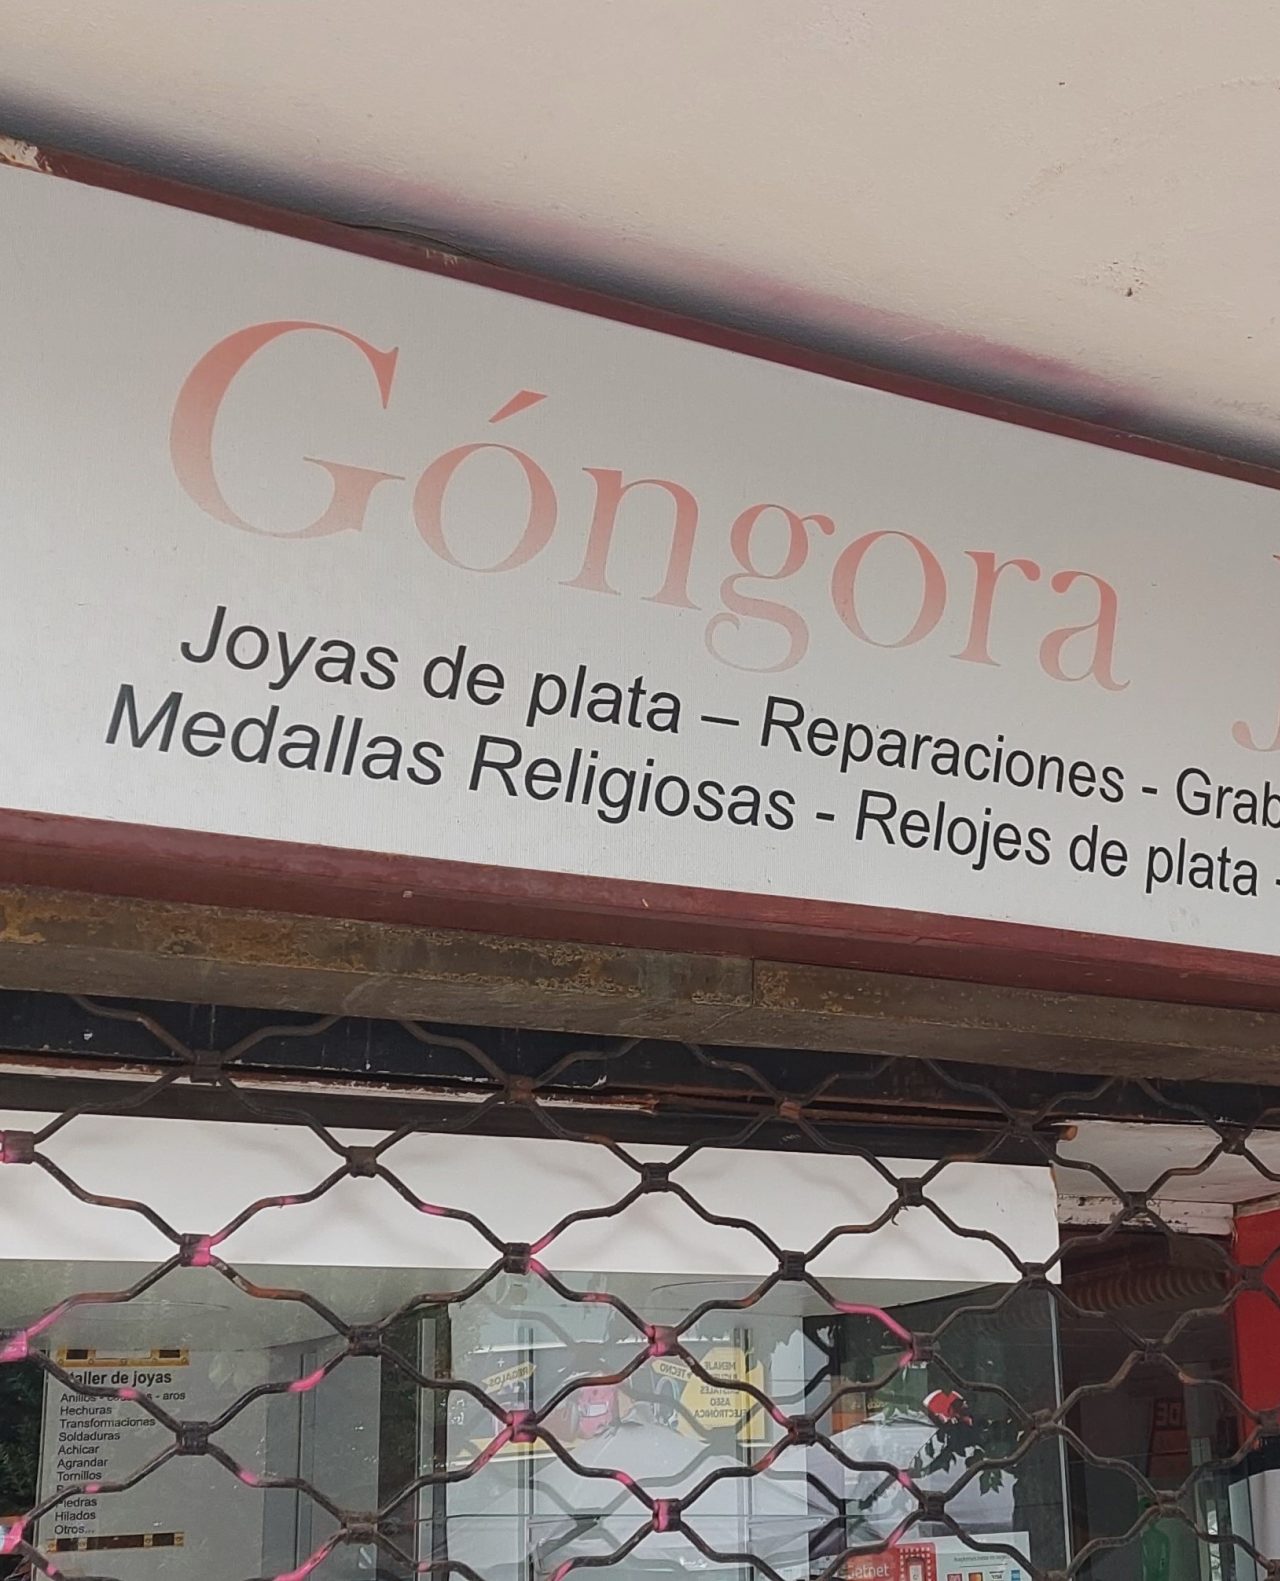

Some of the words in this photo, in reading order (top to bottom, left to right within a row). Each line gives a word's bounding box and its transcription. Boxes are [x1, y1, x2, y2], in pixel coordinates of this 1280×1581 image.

[169, 319, 1131, 692] Góngora
[180, 605, 400, 690] Joyas
[421, 645, 505, 705] de
[526, 664, 682, 734] plata
[761, 695, 1125, 802] Reparaciones
[104, 683, 445, 785] Medallas
[468, 734, 796, 831] Religiosas
[855, 789, 1052, 873] Relojes
[1069, 824, 1129, 877] de
[1146, 838, 1258, 898] plata
[111, 1371, 129, 1385] de
[131, 1371, 172, 1387] joyas
[163, 1392, 186, 1401] aros
[60, 1406, 112, 1416] Hechuras
[60, 1417, 156, 1429] Transformaciones
[58, 1431, 121, 1442] Soldaduras
[57, 1444, 100, 1455] Achicar
[57, 1458, 108, 1469] Agrandar
[57, 1470, 102, 1482] Tornillos
[54, 1511, 96, 1522] Hilados
